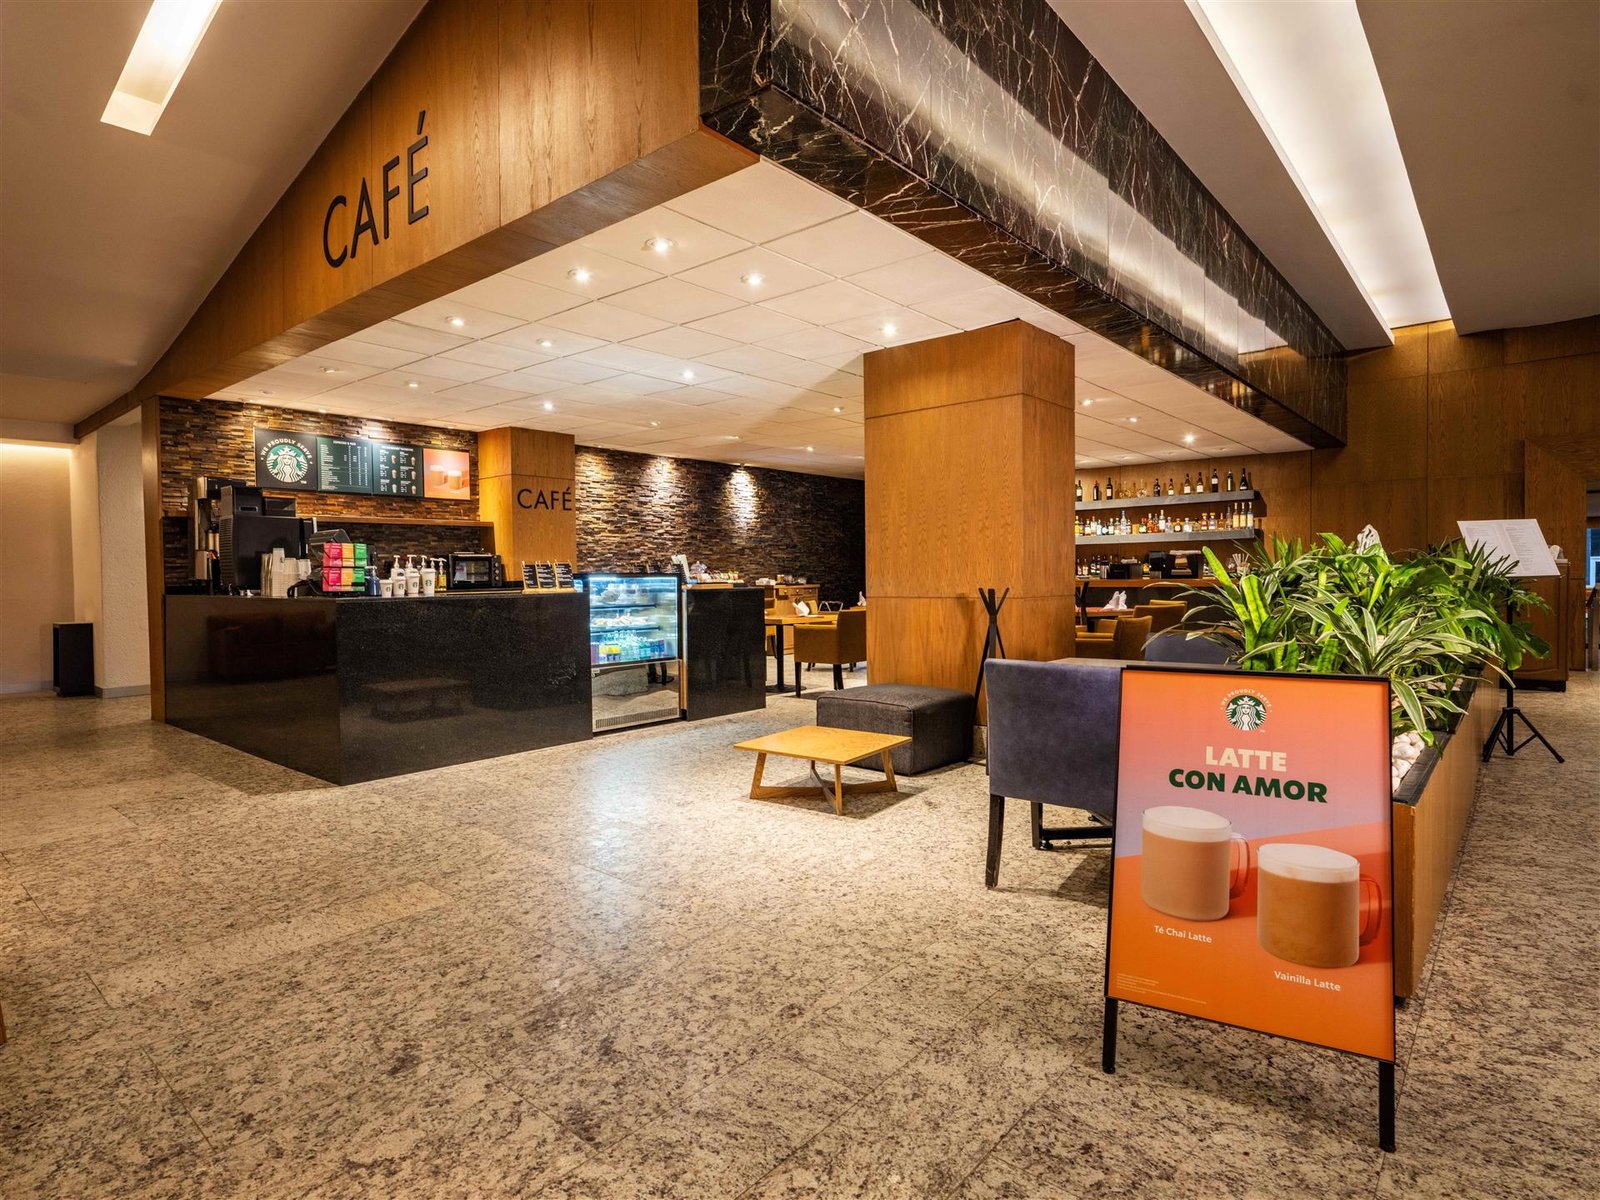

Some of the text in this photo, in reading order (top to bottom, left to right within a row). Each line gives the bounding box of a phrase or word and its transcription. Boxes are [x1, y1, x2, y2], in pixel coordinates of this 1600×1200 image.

[323, 110, 429, 268] CAFÉ
[260, 438, 312, 459] WE PROUDLY SERVE
[517, 486, 572, 511] CAFÉ
[1228, 688, 1256, 697] PROUDLY
[1205, 746, 1287, 772] LATTE
[1169, 768, 1327, 803] CON AMOR
[1154, 925, 1212, 943] Té Chai Latte
[1274, 970, 1341, 992] Vainilla Latte
